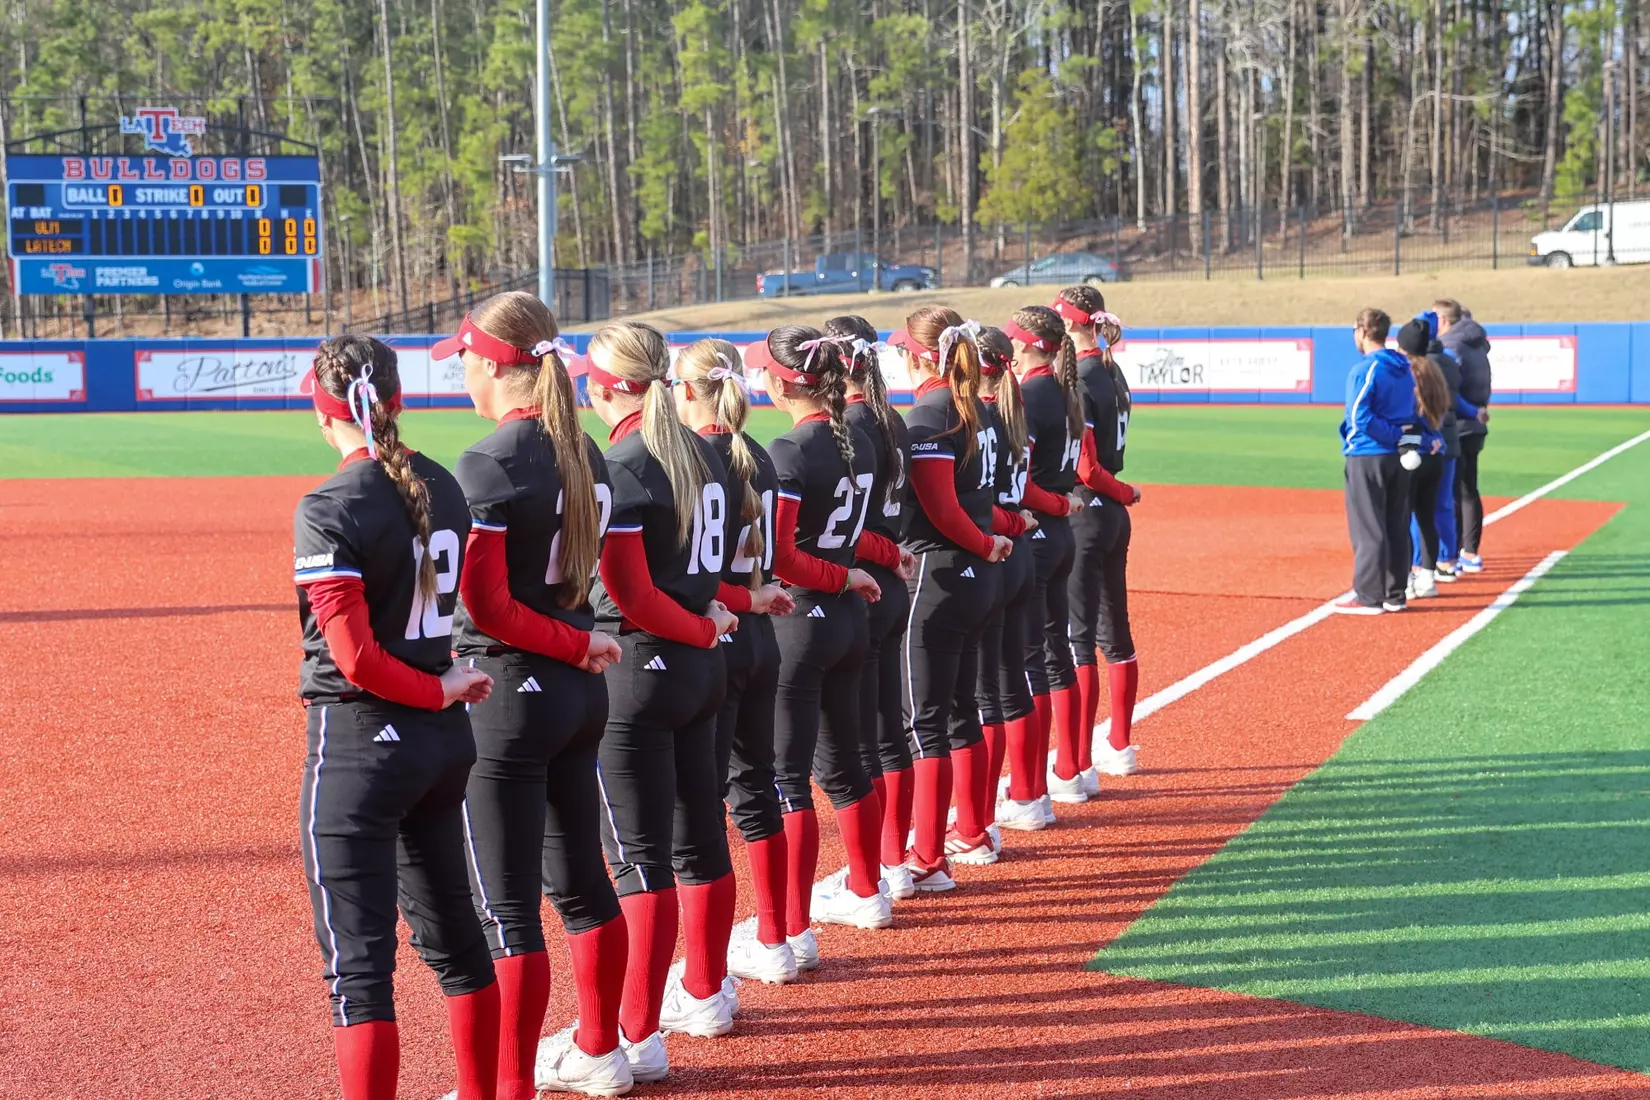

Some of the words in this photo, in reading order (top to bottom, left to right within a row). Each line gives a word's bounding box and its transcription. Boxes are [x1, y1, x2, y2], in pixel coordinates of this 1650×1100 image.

[62, 157, 267, 180] BULLDOGS
[66, 188, 107, 203] BALL
[107, 184, 123, 207] 0
[135, 188, 188, 204] STRIKE
[189, 184, 204, 207] 0
[213, 188, 244, 203] OUT
[246, 184, 260, 207] 0
[11, 206, 26, 219] AT
[30, 206, 53, 219] BAT
[92, 209, 98, 219] 1
[107, 209, 115, 219] 2
[123, 209, 131, 219] 3
[138, 209, 147, 219] 4
[186, 209, 193, 219] 7
[216, 209, 225, 219] 9
[230, 209, 243, 219] 10
[258, 218, 271, 237] 0
[285, 218, 297, 237] 0
[304, 218, 316, 237] 0
[259, 236, 271, 255] 0
[285, 236, 298, 255] 0
[304, 236, 316, 255] 0
[95, 276, 160, 287] PARTNERS
[173, 355, 298, 392] Patton's
[1137, 363, 1204, 384] TAYLOR
[817, 473, 873, 549] 27
[687, 482, 725, 574] 18
[404, 528, 460, 640] 12
